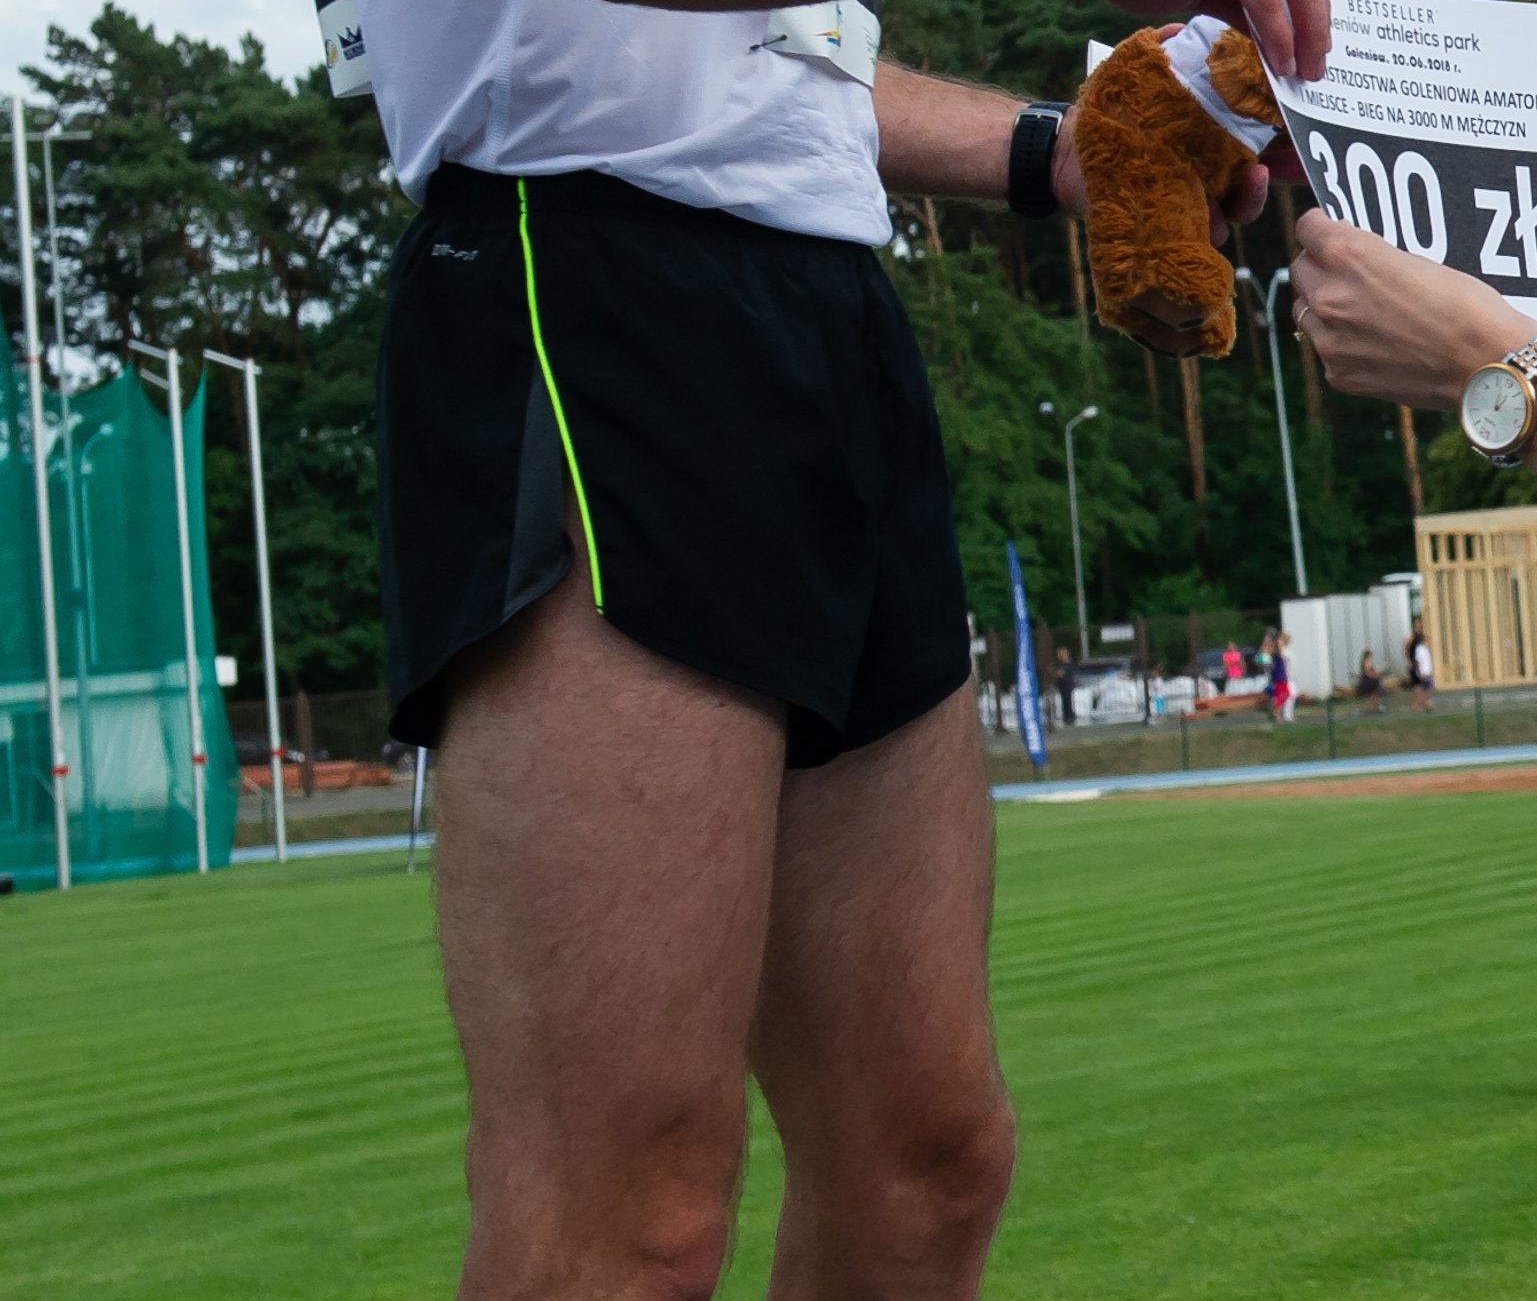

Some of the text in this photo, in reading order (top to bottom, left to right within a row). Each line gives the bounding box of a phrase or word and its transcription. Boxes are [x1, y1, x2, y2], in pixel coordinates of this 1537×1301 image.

[1331, 15, 1481, 53] eniów athletics park
[1392, 53, 1451, 72] 20.06.2018
[1454, 64, 1462, 73] r.
[1323, 65, 1398, 94] ISTRZOSTWA
[1400, 80, 1480, 105] GOLENIOWA
[1305, 88, 1349, 114] MIEJSCE
[1357, 101, 1384, 120] BIEG
[1387, 106, 1406, 125] NA
[1408, 109, 1438, 129] 3000
[1441, 114, 1454, 131] M
[1457, 114, 1527, 138] MĘŻCZYZN
[1309, 130, 1448, 266] 300
